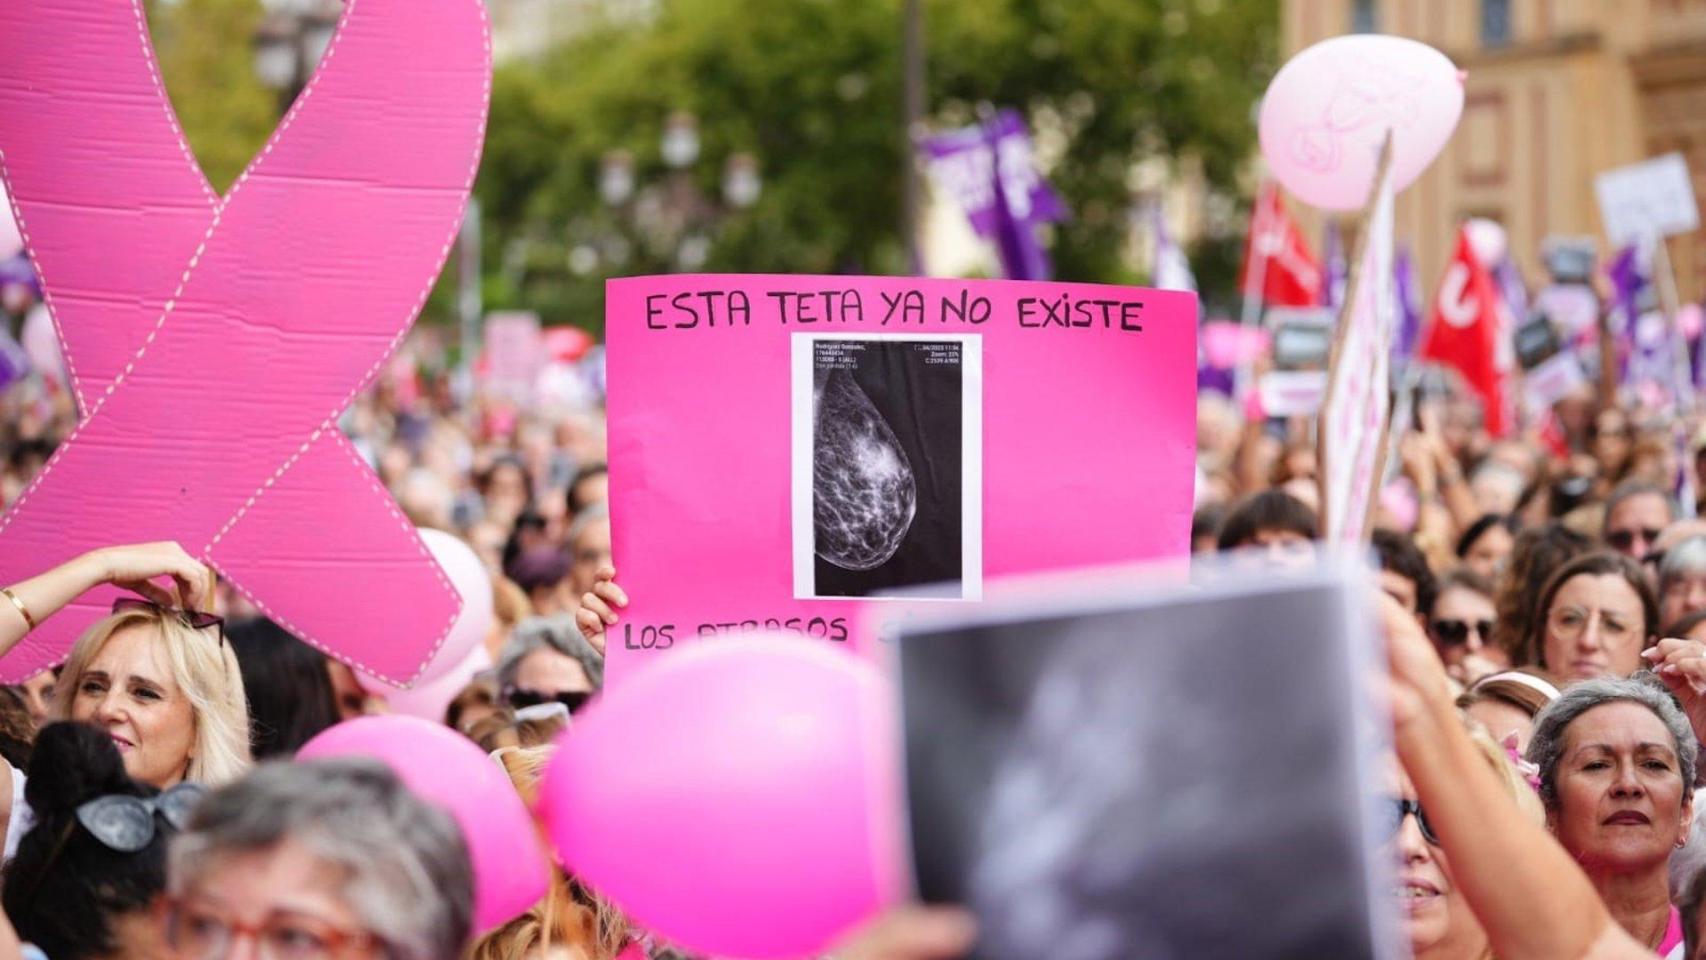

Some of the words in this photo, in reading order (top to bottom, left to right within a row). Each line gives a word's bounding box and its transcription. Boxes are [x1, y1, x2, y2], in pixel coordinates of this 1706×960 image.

[646, 290, 750, 329] ESTA
[767, 289, 863, 324] TETA
[881, 289, 924, 325] YA
[941, 289, 991, 324] NO
[624, 623, 675, 650] LOS
